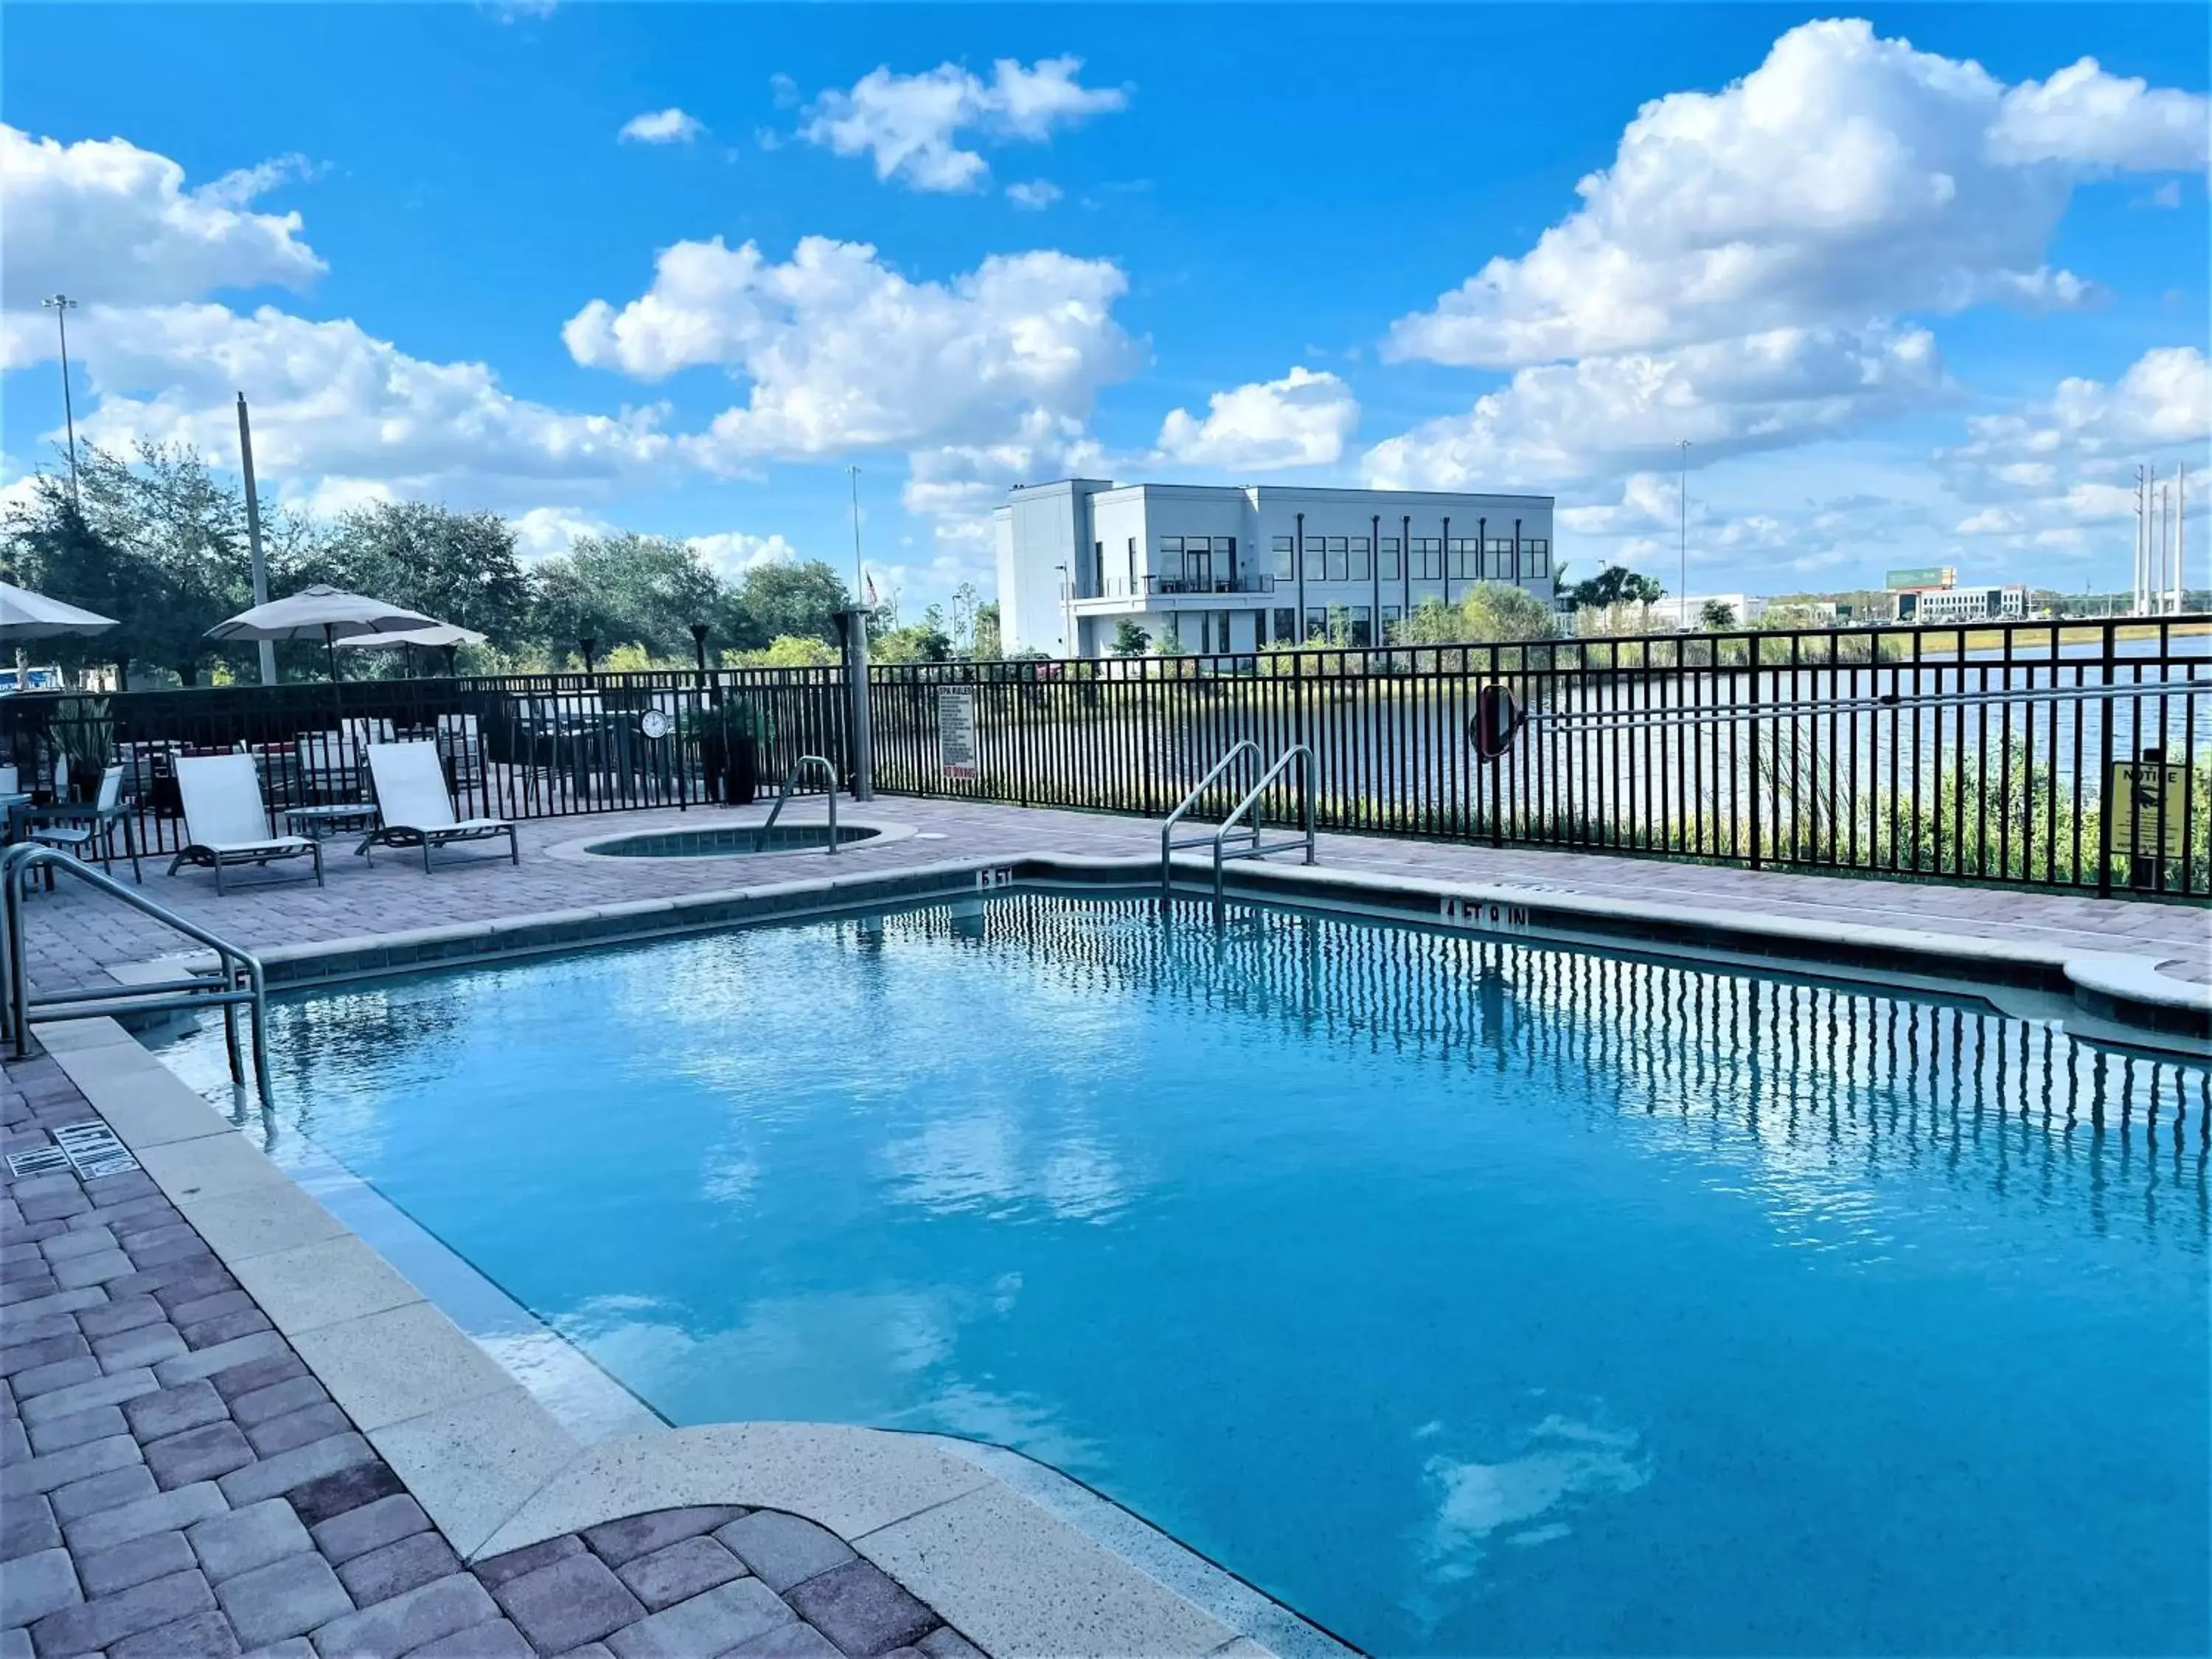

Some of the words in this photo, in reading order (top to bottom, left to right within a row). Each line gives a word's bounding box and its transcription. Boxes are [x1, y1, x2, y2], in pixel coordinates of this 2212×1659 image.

[2123, 769, 2177, 783] NTIE
[1464, 902, 1483, 919] FT
[1508, 907, 1526, 925] IN
